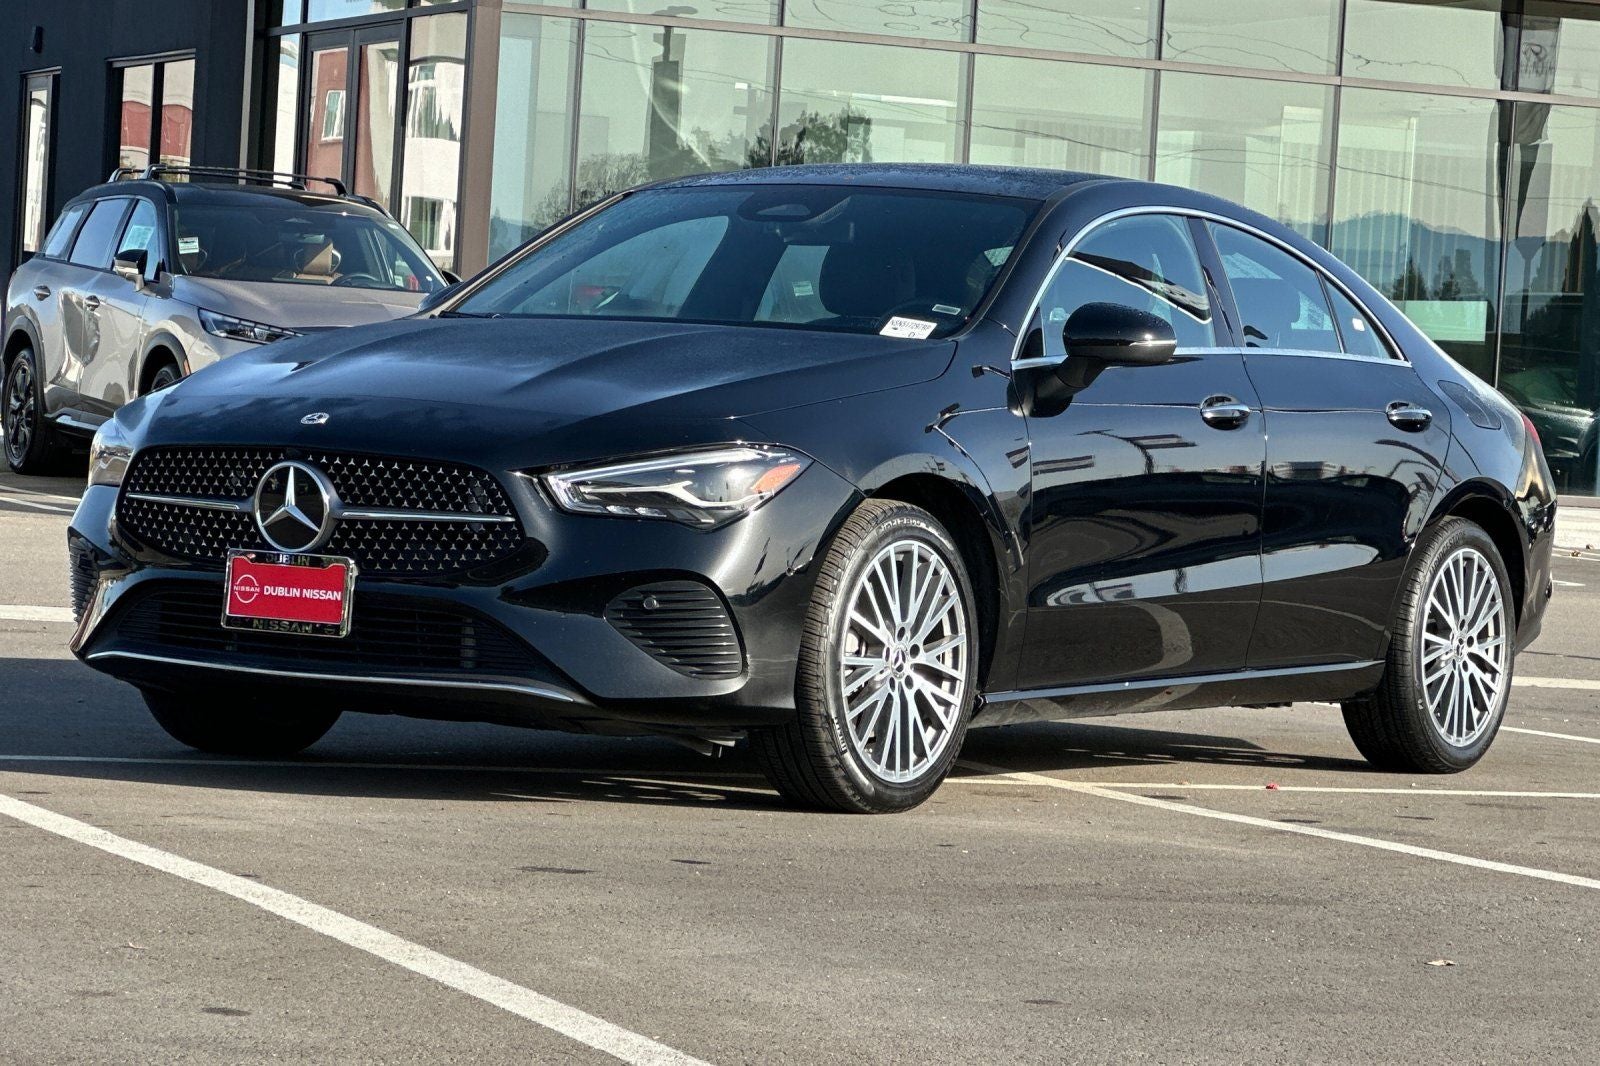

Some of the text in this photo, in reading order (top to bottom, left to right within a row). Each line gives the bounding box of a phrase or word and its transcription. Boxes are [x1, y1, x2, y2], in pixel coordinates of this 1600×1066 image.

[265, 553, 310, 566] DUBLIN
[233, 585, 260, 593] NISSAN
[263, 585, 341, 601] DUBLIN NISSAN
[252, 619, 313, 634] NISSAN
